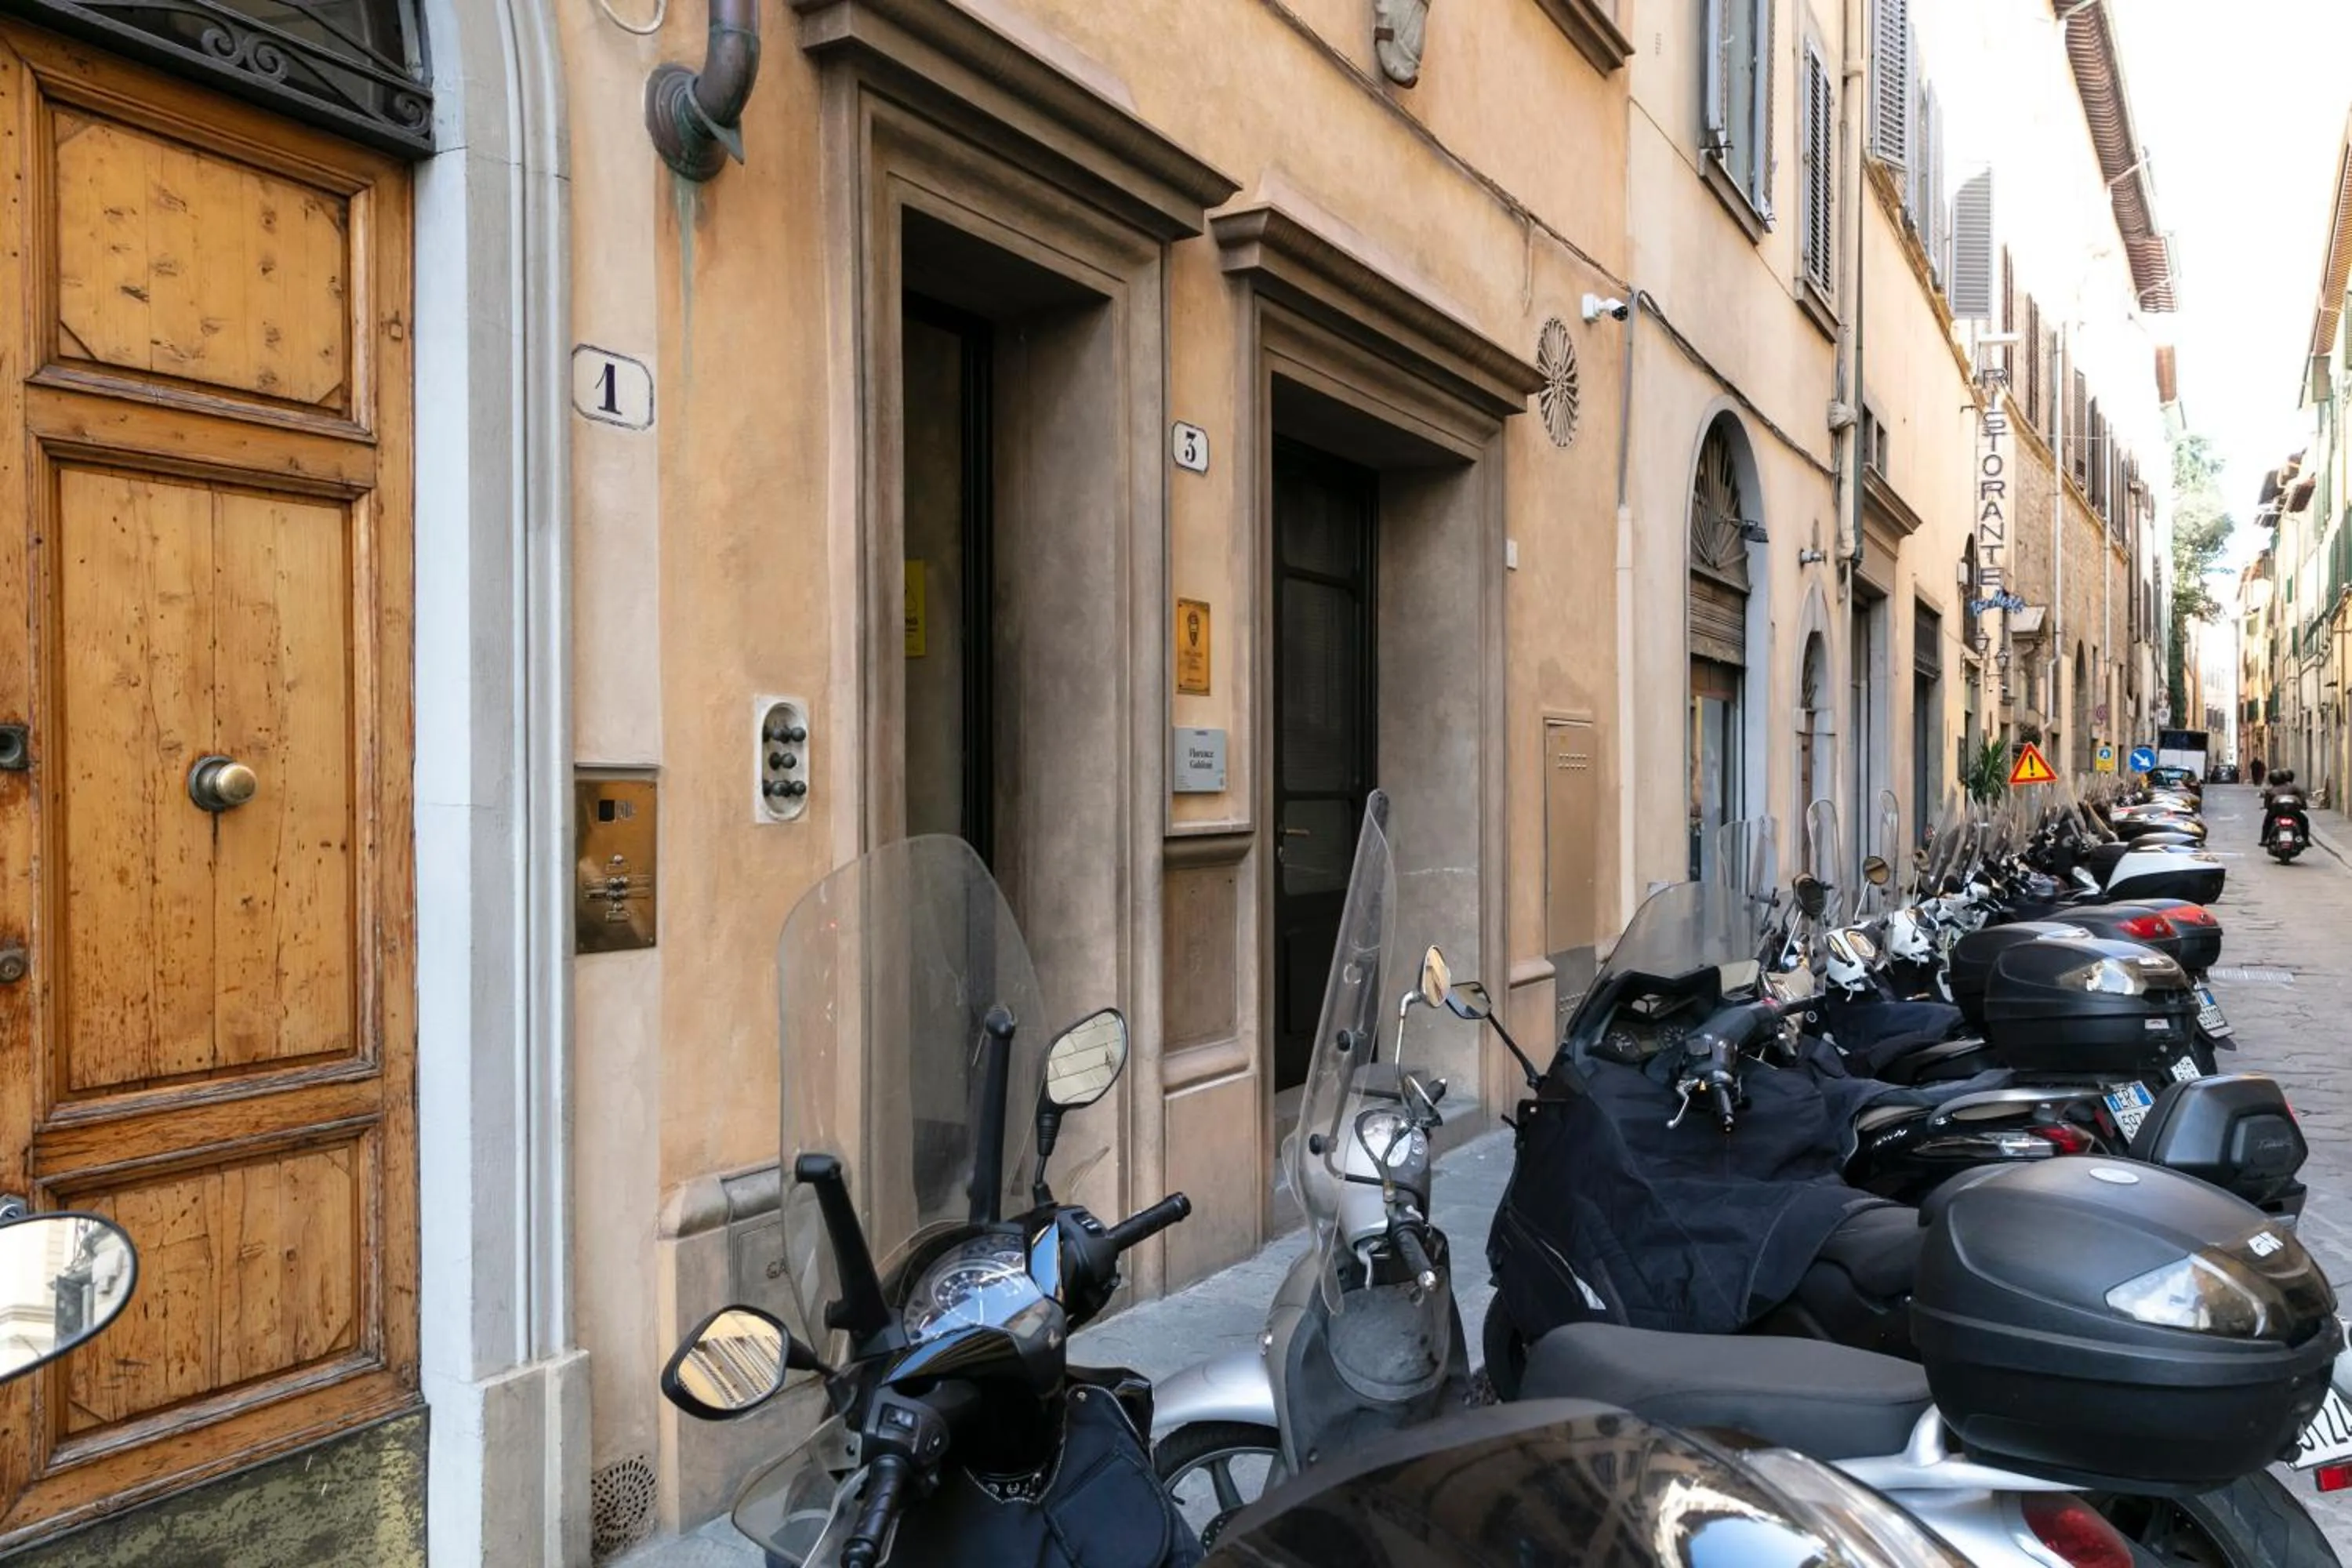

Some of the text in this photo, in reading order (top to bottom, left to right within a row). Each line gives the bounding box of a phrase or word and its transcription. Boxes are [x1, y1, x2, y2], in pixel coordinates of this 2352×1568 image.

[594, 363, 622, 416] 1
[1185, 430, 1196, 463] 3
[1980, 368, 2007, 585] RISTORANTE
